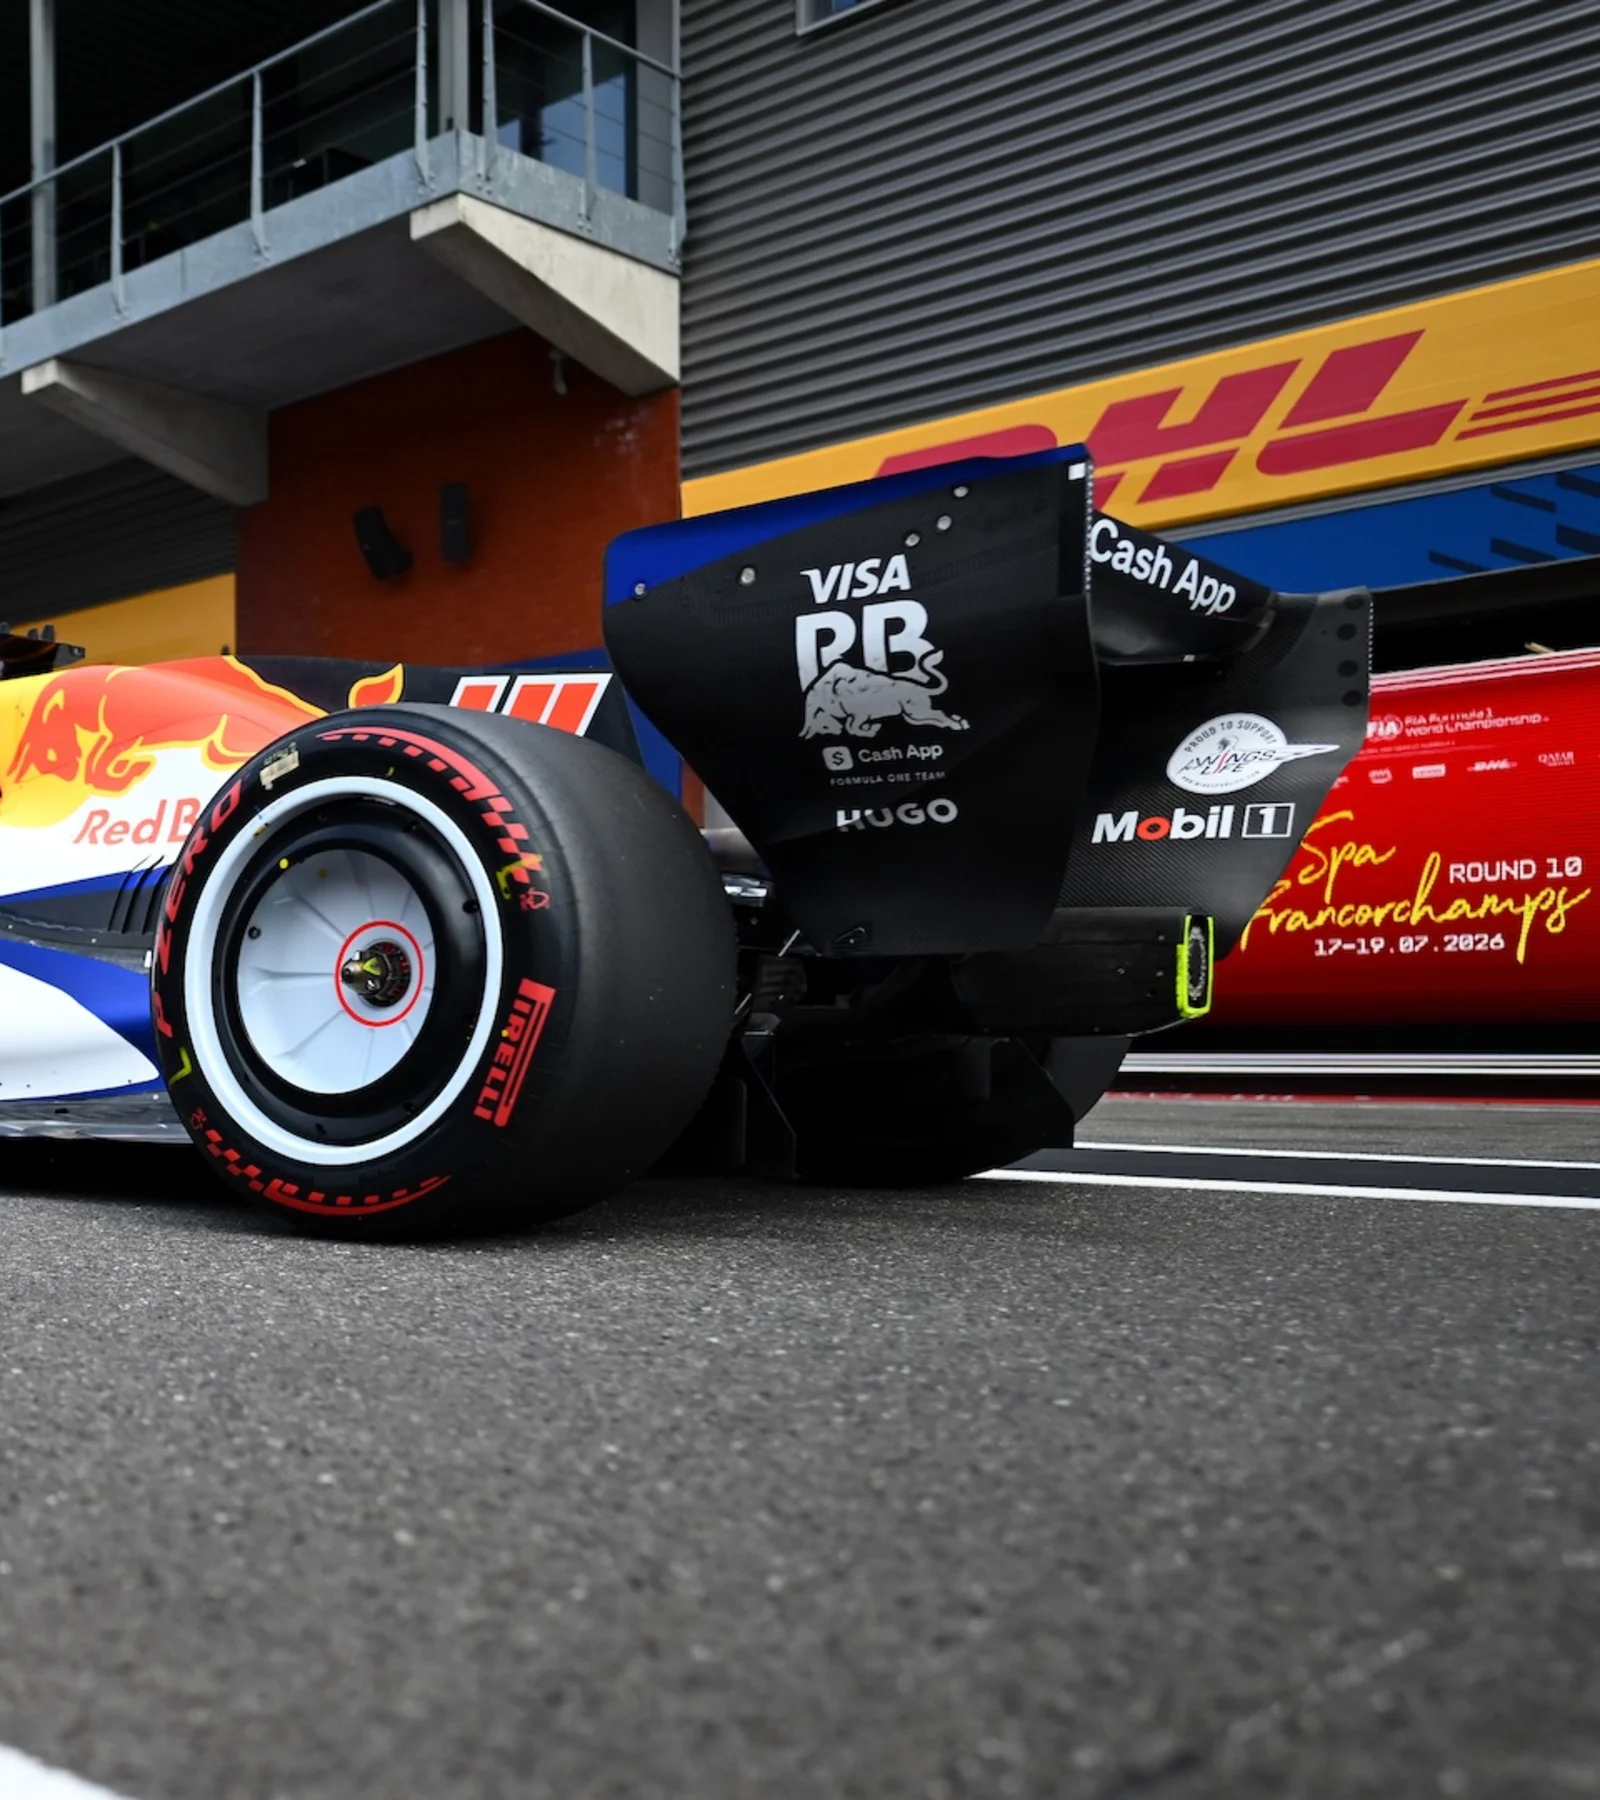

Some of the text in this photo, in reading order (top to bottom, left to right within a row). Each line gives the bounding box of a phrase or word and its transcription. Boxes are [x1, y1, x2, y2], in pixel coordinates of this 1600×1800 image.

[874, 328, 1469, 510] HL
[800, 554, 911, 603] VISA
[1090, 518, 1236, 616] Cash App
[796, 600, 936, 692] RB
[858, 746, 903, 763] Cash
[906, 743, 943, 760] App
[1184, 719, 1277, 753] PROUD TO SUPPORT
[1366, 720, 1398, 739] FIA
[830, 771, 946, 786] FORMULA ONE TEAM
[73, 798, 168, 846] Red
[836, 799, 958, 832] HUGO
[1091, 805, 1235, 844] Mobil
[158, 779, 242, 976] ZERO
[1298, 810, 1396, 904] Spa
[1449, 856, 1583, 884] ROUND 10
[1240, 852, 1591, 965] Francorchamps
[1314, 933, 1505, 957] 17-19.07.2026
[473, 977, 557, 1128] PIRELLI
